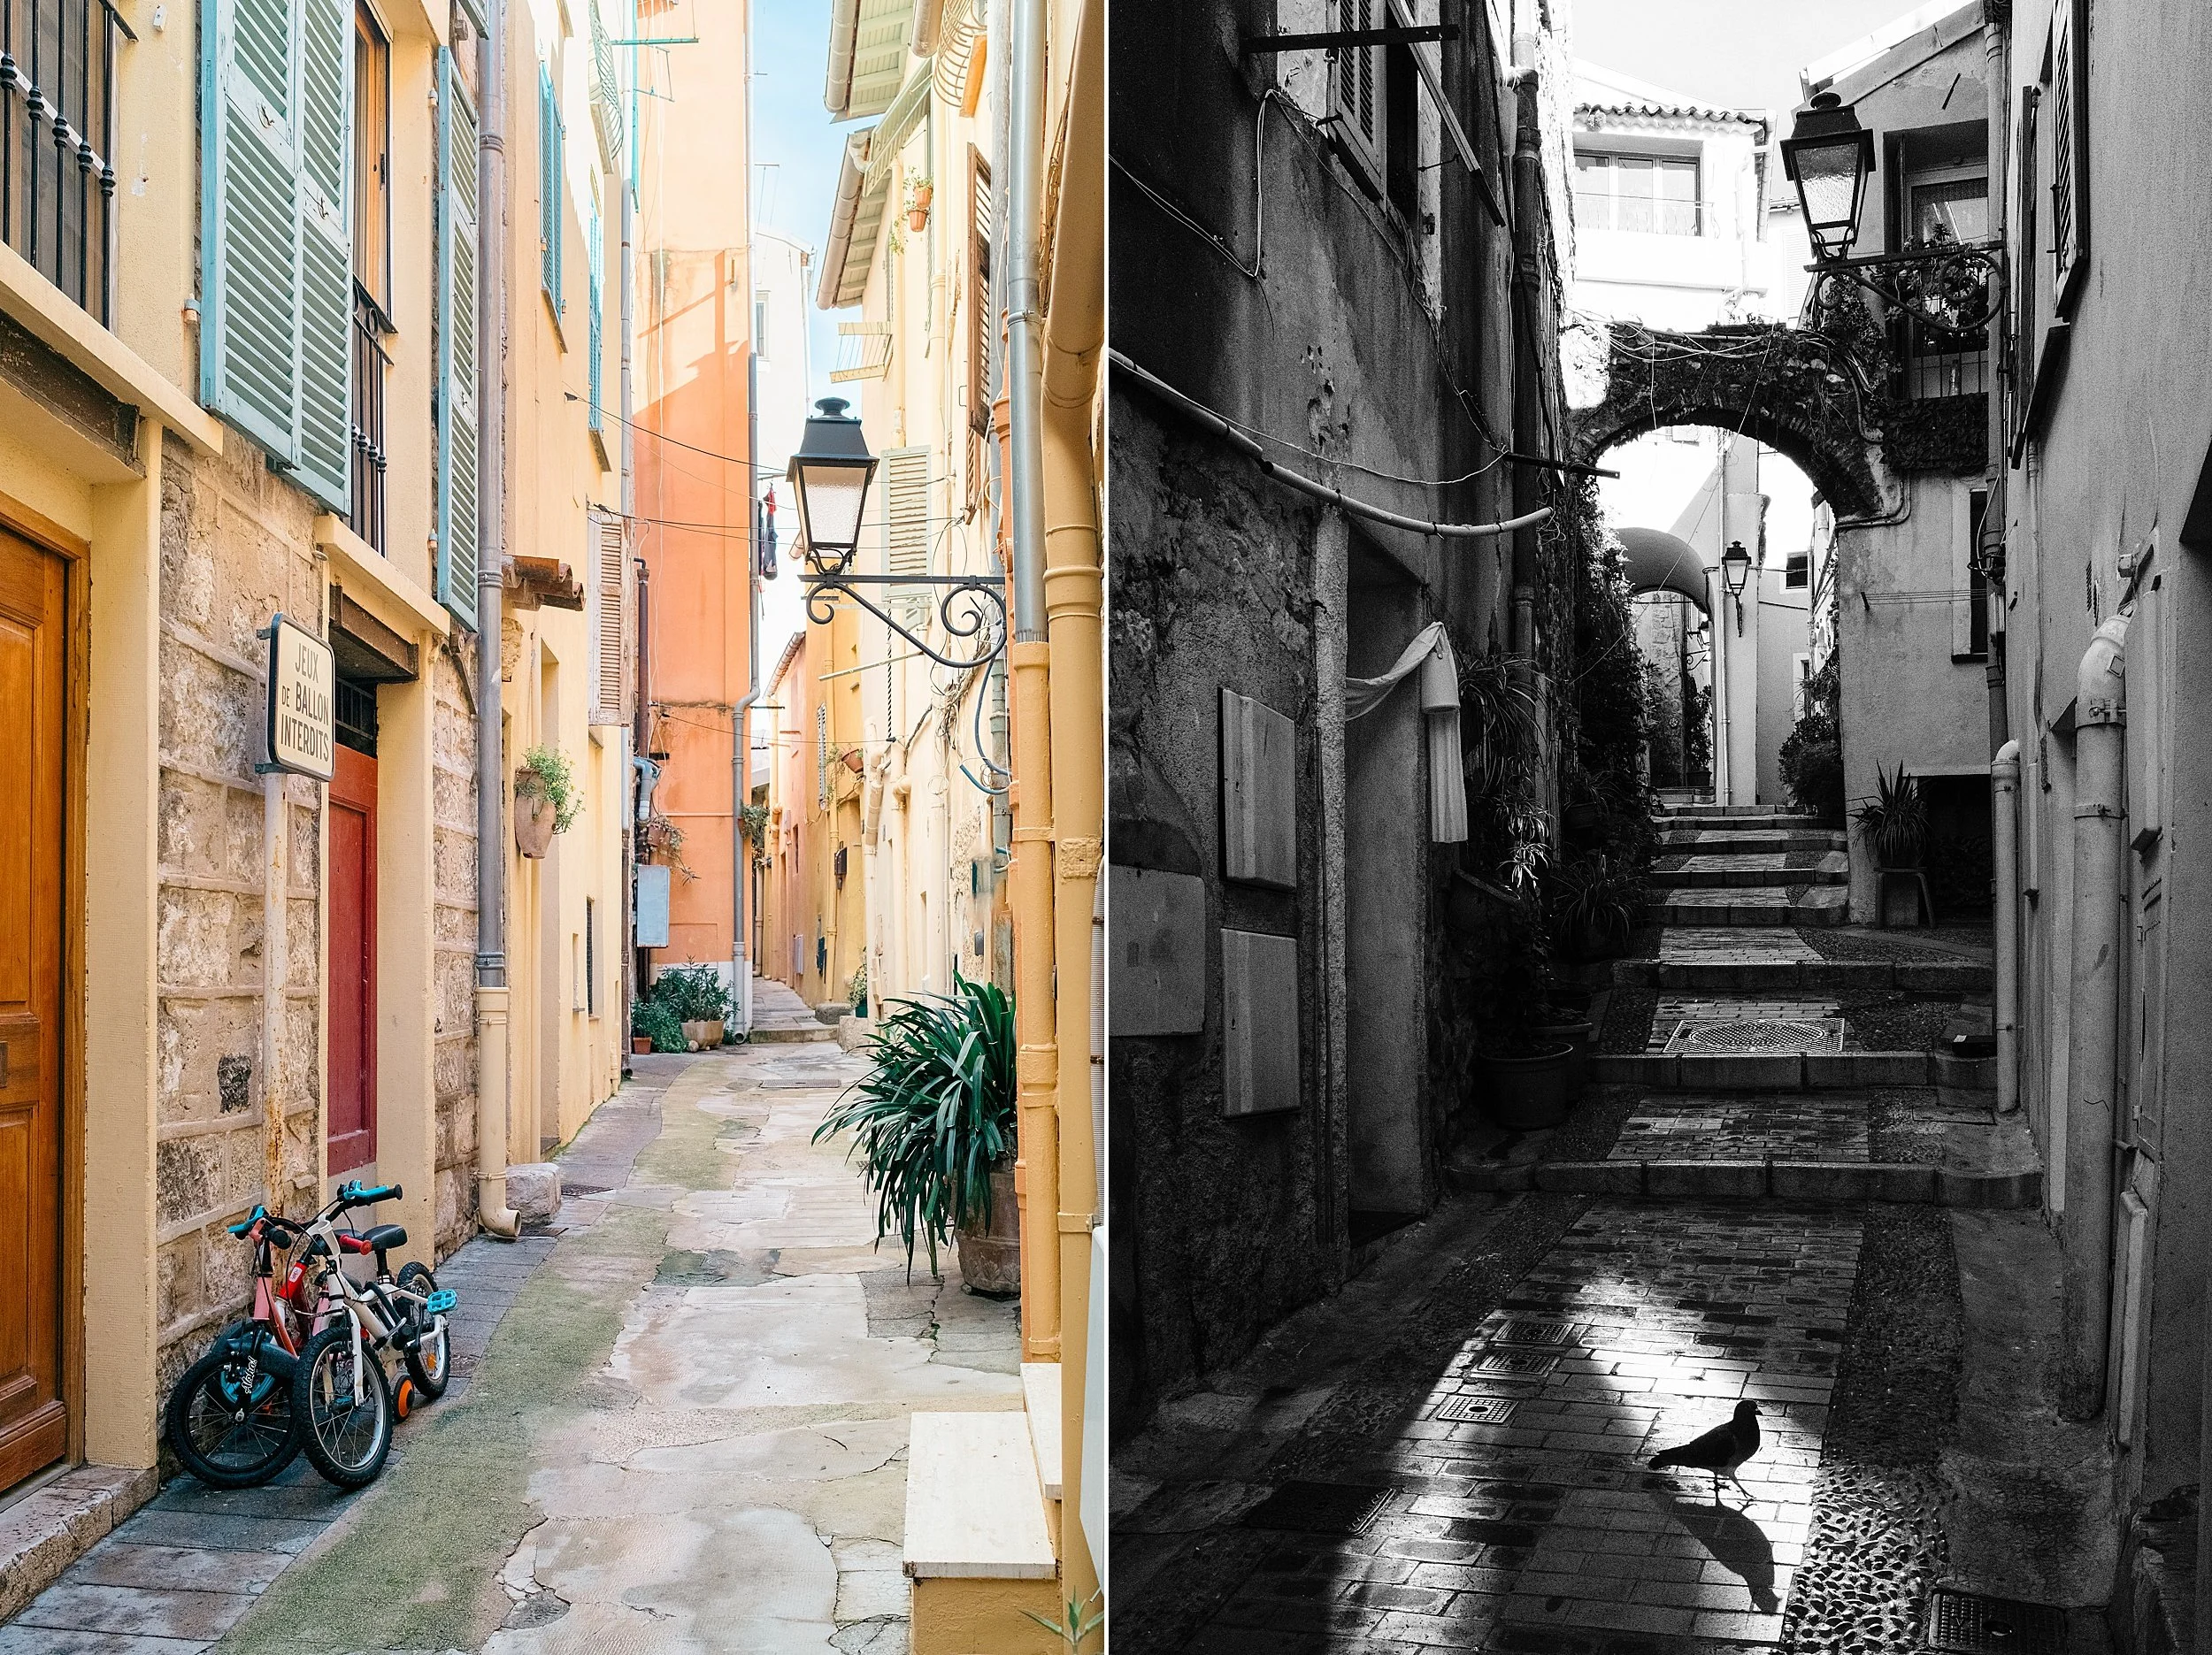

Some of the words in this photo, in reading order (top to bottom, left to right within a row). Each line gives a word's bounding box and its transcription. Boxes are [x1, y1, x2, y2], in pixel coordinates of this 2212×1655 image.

[295, 642, 319, 684] JEUX
[281, 685, 290, 708] DE
[296, 680, 329, 726] BALLON
[280, 713, 329, 762] INTERDITS
